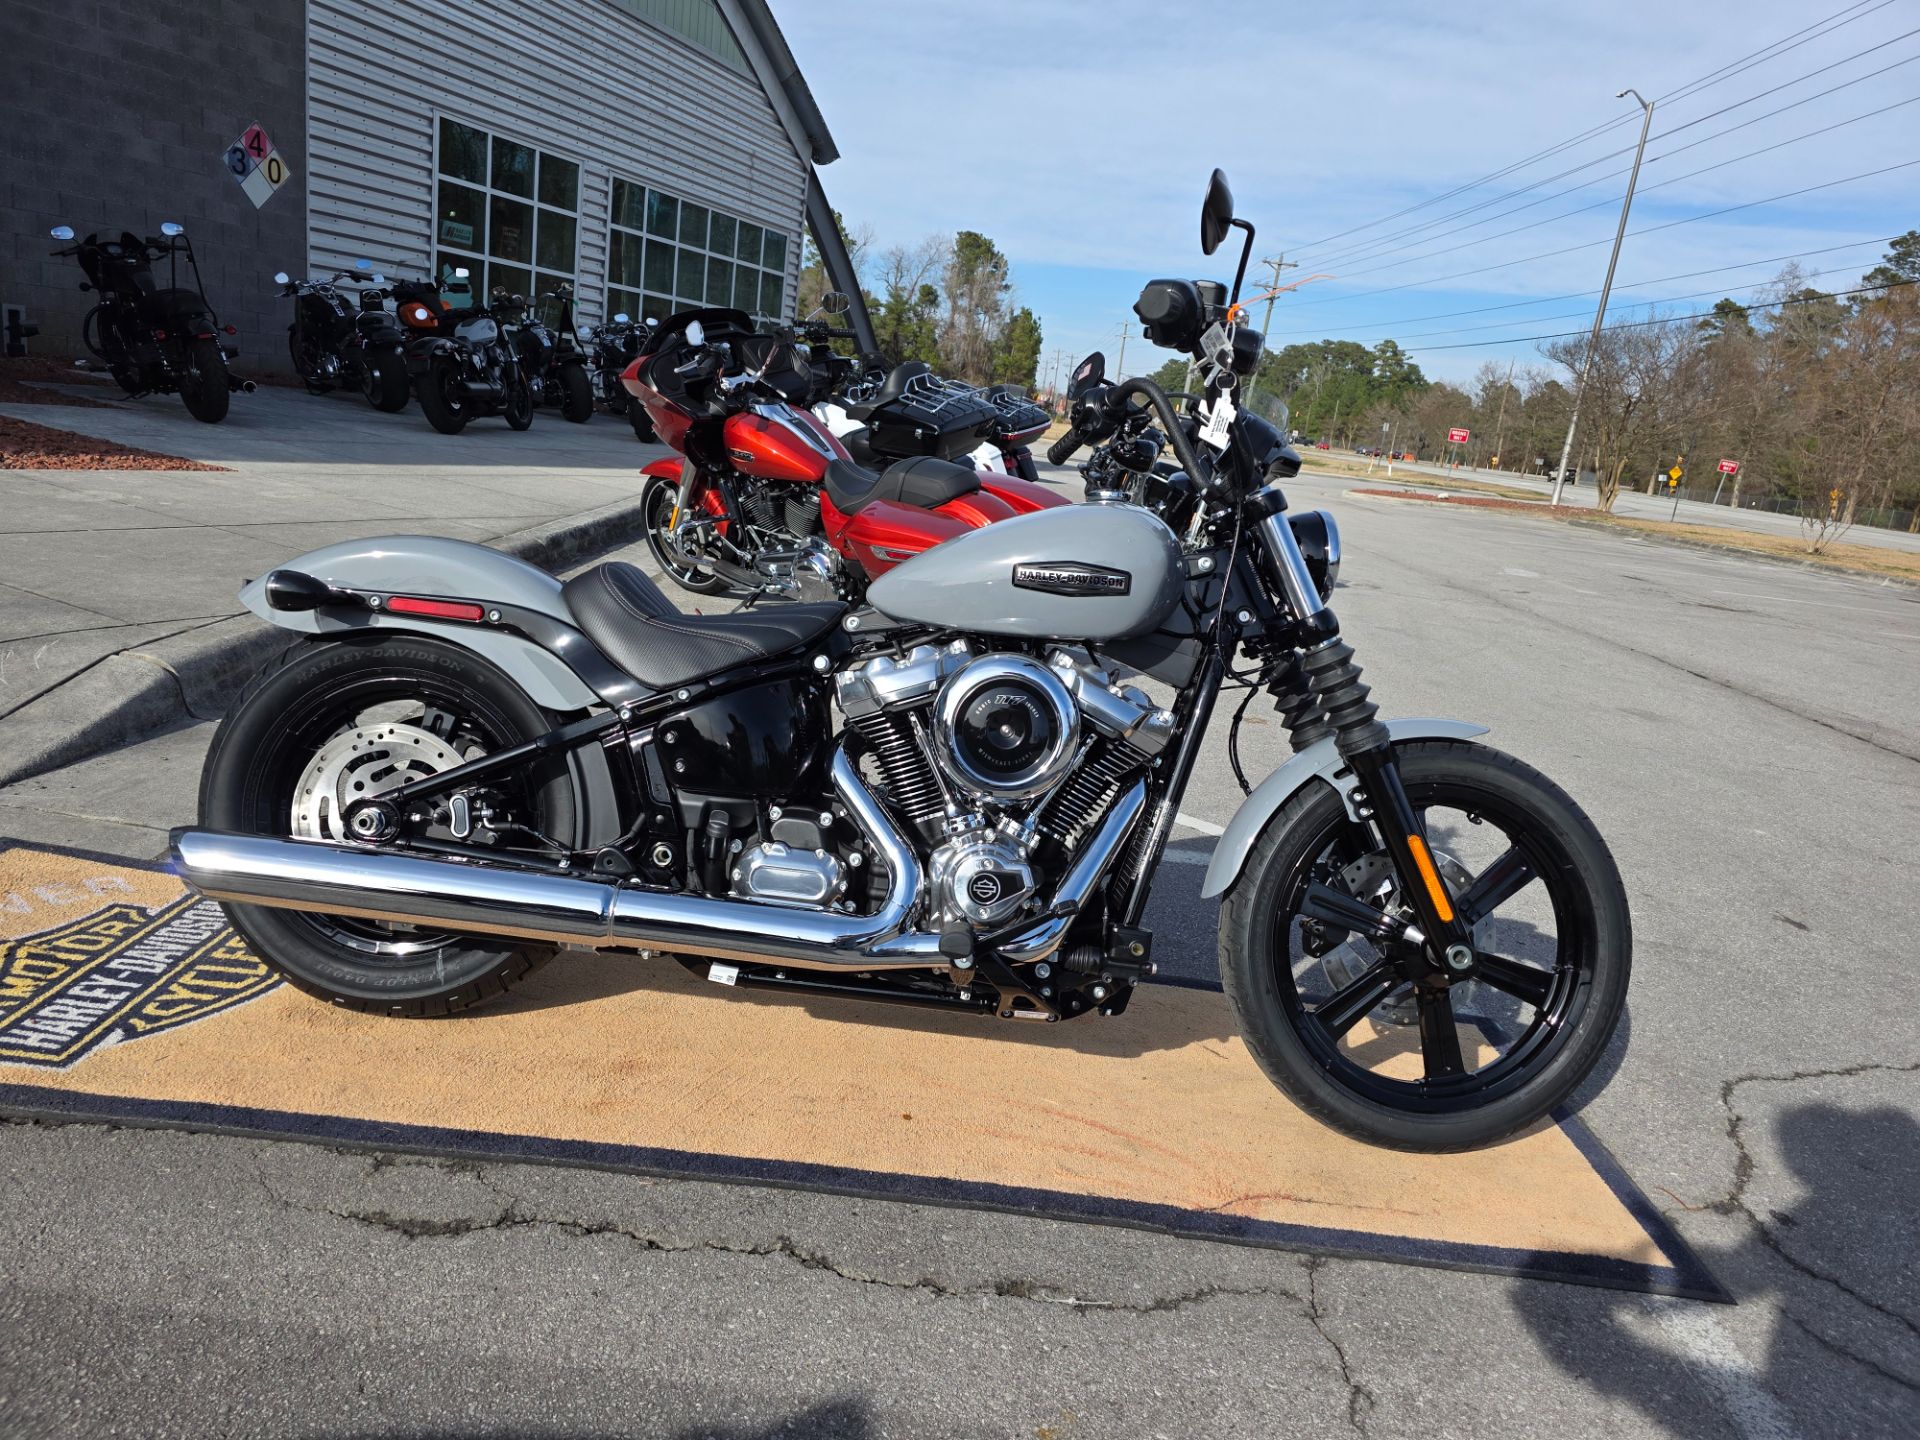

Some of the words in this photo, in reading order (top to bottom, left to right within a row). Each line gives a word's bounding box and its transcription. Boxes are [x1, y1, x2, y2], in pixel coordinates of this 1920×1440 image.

[249, 131, 263, 157] 4
[232, 147, 246, 175] 3
[267, 158, 281, 184] 0
[1018, 570, 1124, 588] HARLEY-DAVIDSON
[298, 648, 465, 683] HARLEY-DAVIDSON
[993, 694, 1028, 705] 117
